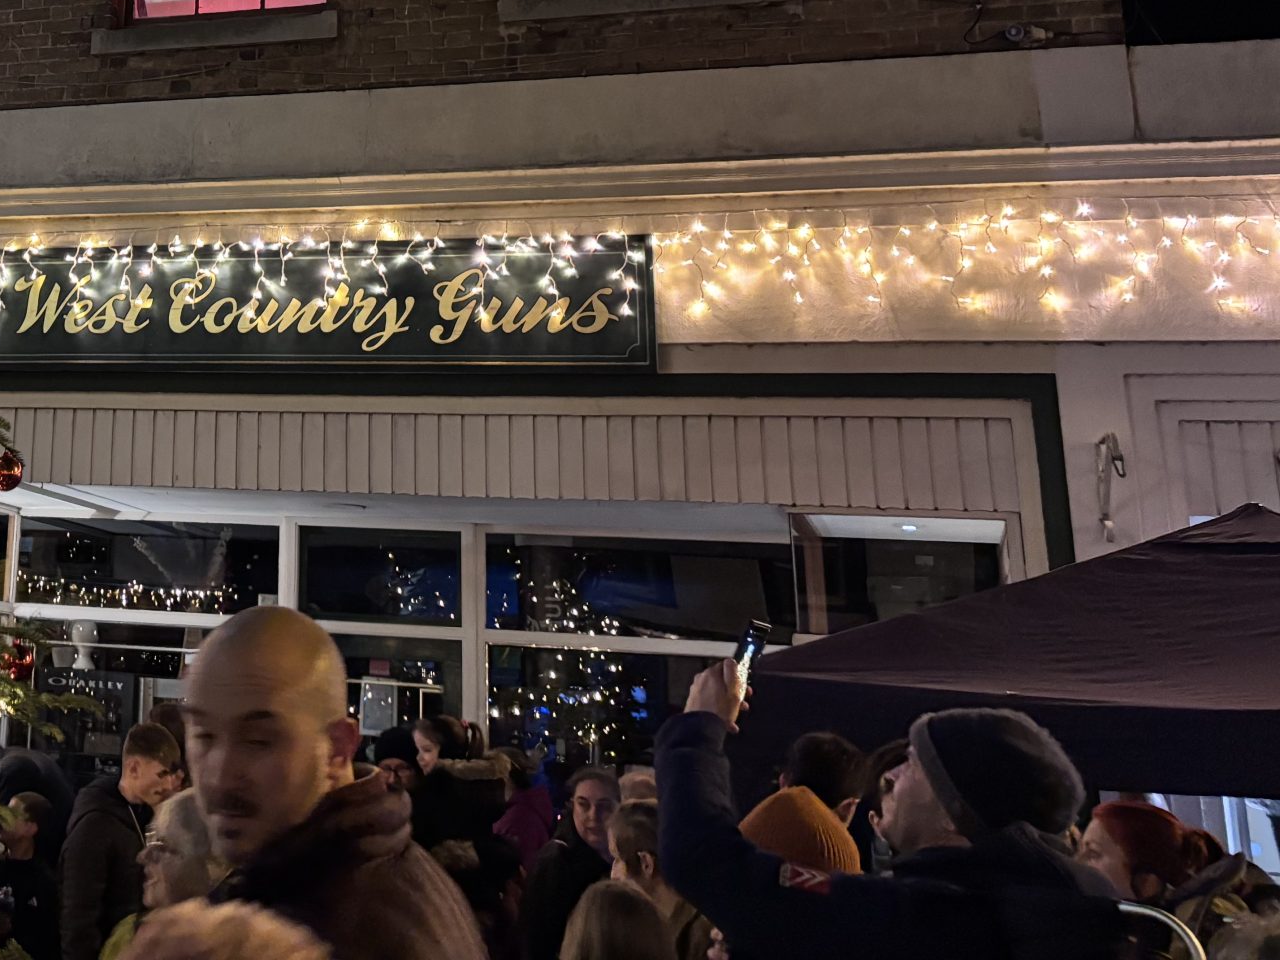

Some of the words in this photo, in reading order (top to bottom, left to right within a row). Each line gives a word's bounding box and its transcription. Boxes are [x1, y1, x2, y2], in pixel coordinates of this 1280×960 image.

[15, 273, 154, 334] West
[169, 267, 415, 352] Country
[429, 268, 619, 344] Guns
